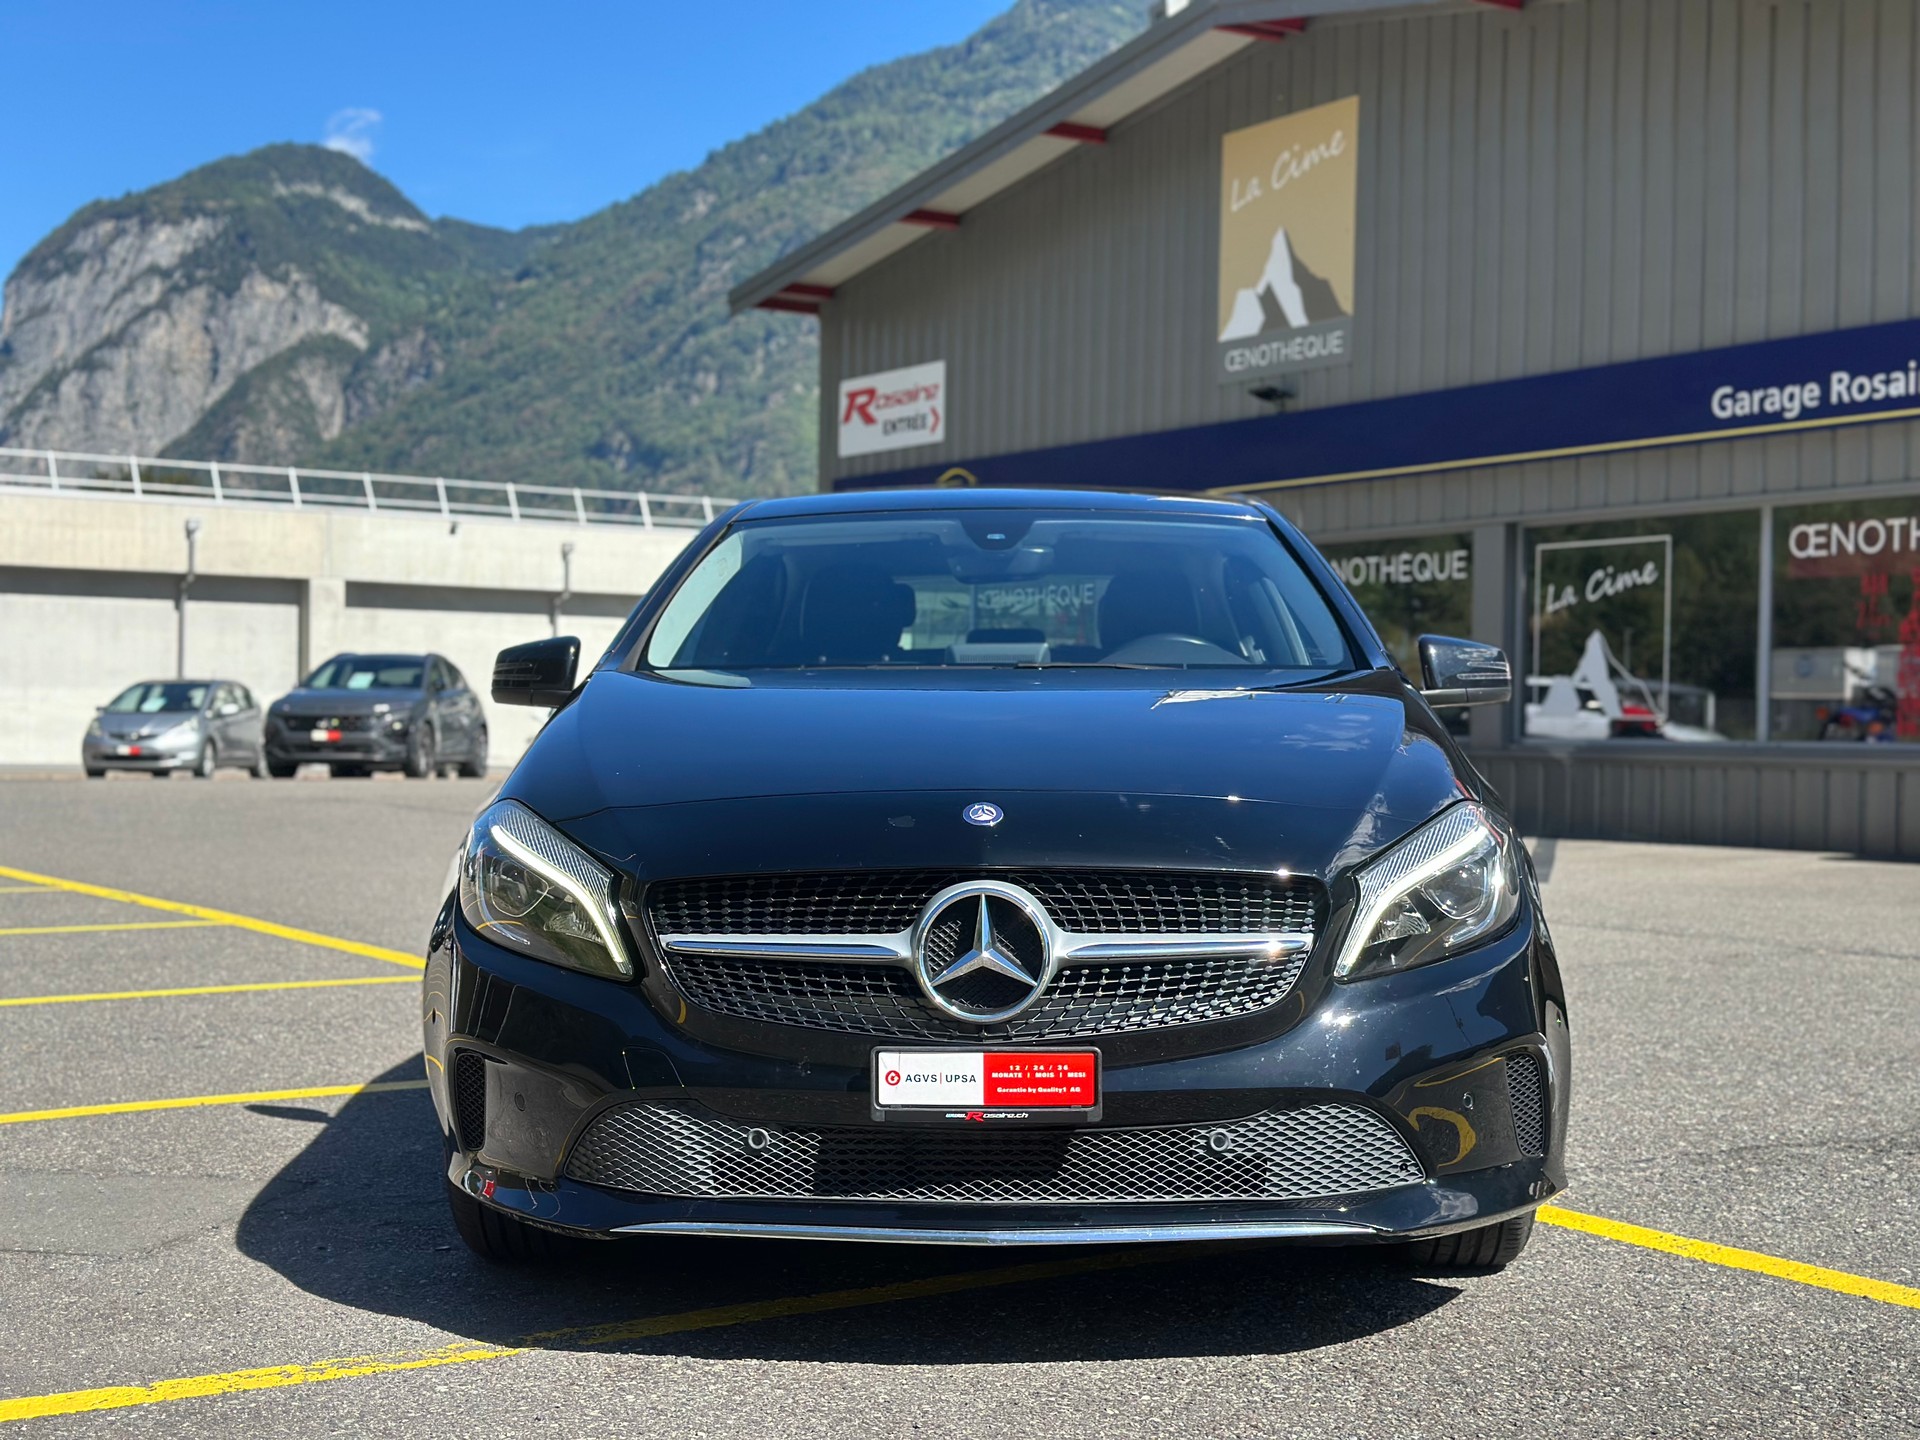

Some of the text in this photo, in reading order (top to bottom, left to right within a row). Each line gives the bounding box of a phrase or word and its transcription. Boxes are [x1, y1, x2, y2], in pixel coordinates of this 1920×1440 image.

[1230, 130, 1345, 213] La Cime
[1711, 359, 1920, 420] Garage Rosai
[1546, 561, 1659, 613] La Cime
[905, 1074, 977, 1083] AGVS UPSA
